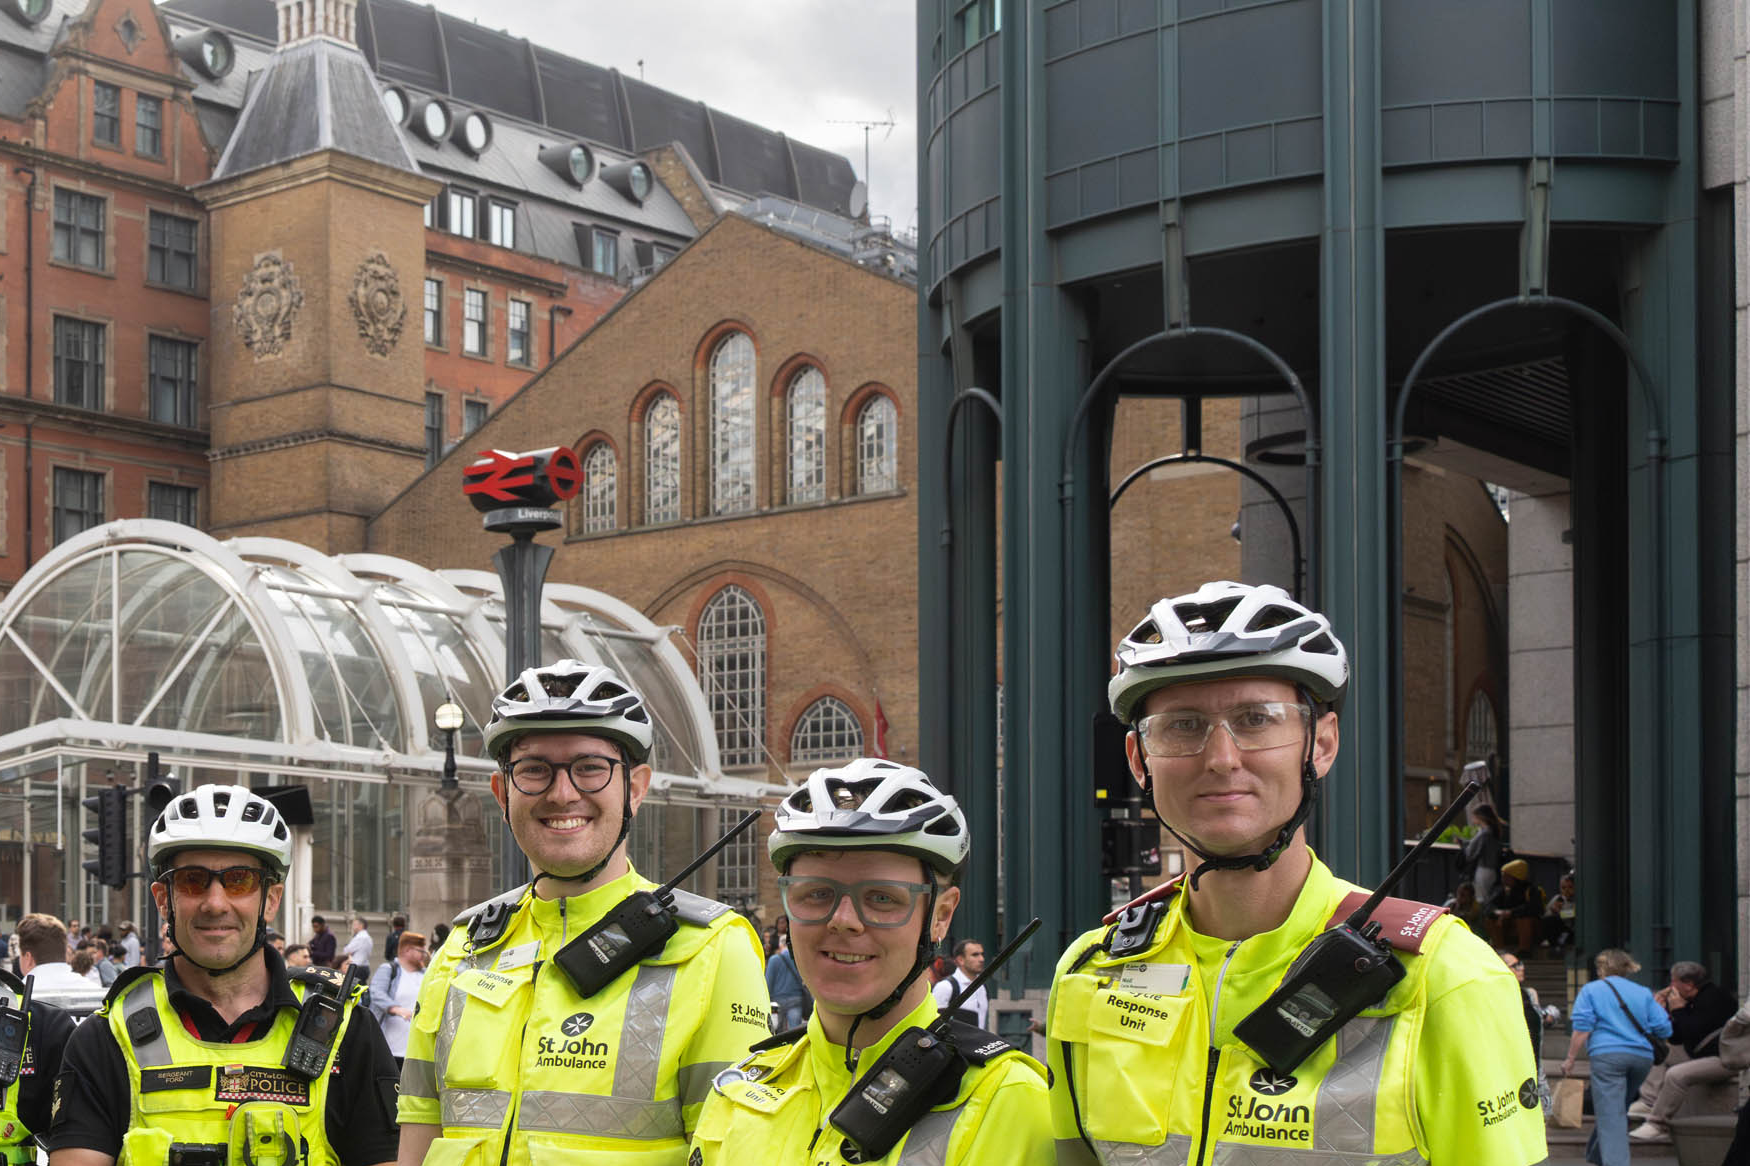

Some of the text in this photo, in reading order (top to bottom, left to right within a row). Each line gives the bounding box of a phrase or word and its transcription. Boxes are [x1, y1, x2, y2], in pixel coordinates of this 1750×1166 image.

[1400, 907, 1430, 937] St John
[477, 979, 497, 991] Unit
[730, 1003, 766, 1020] St John
[1106, 994, 1169, 1021] Response
[1120, 1015, 1147, 1032] Unit
[537, 1036, 609, 1056] St John
[534, 1055, 607, 1069] Ambulance
[157, 1070, 194, 1080] SERGEANT
[250, 1070, 268, 1079] CITY
[251, 1079, 306, 1096] POLICE
[745, 1090, 767, 1104] Unit
[1477, 1090, 1516, 1116] St John
[1227, 1094, 1310, 1123] St John
[1223, 1120, 1310, 1141] Ambulance
